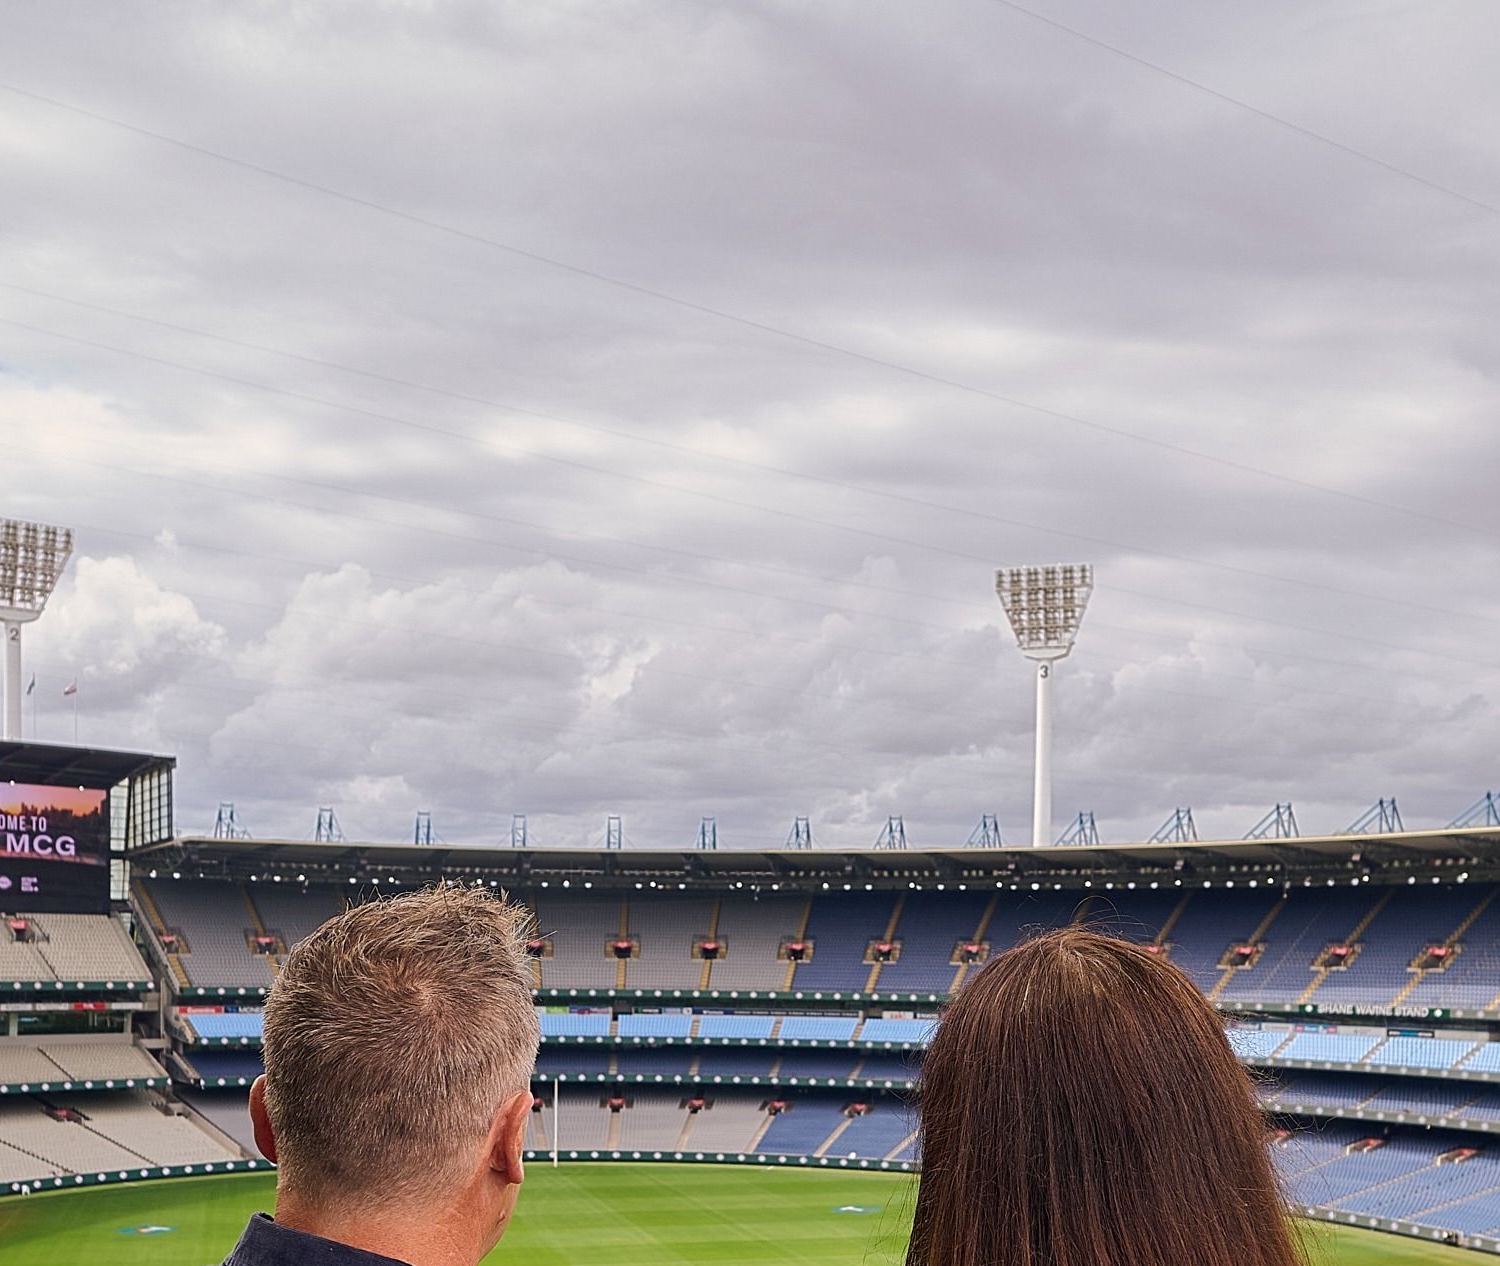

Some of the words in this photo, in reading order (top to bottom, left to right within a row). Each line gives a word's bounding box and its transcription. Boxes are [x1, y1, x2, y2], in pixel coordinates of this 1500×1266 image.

[31, 815, 47, 833] TO
[6, 832, 76, 857] MCG
[1317, 1003, 1353, 1015] SHANE
[1394, 1006, 1430, 1018] STAND
